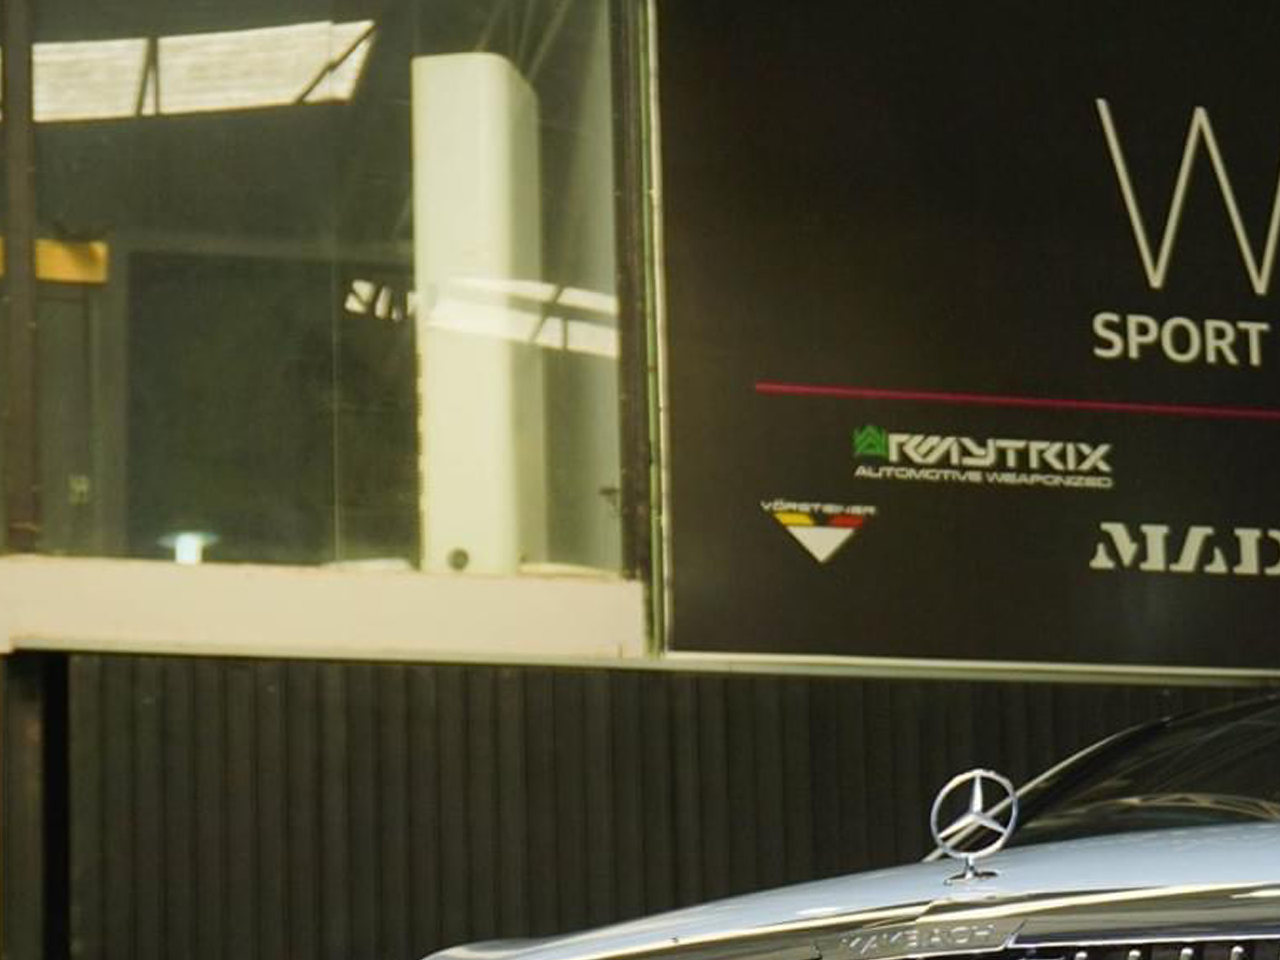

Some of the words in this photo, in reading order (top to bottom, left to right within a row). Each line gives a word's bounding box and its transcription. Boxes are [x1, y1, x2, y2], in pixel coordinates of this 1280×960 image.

[1093, 313, 1269, 366] SPORT
[854, 465, 983, 482] AUTOMOTIVE
[986, 472, 1113, 489] WEAPONIZED
